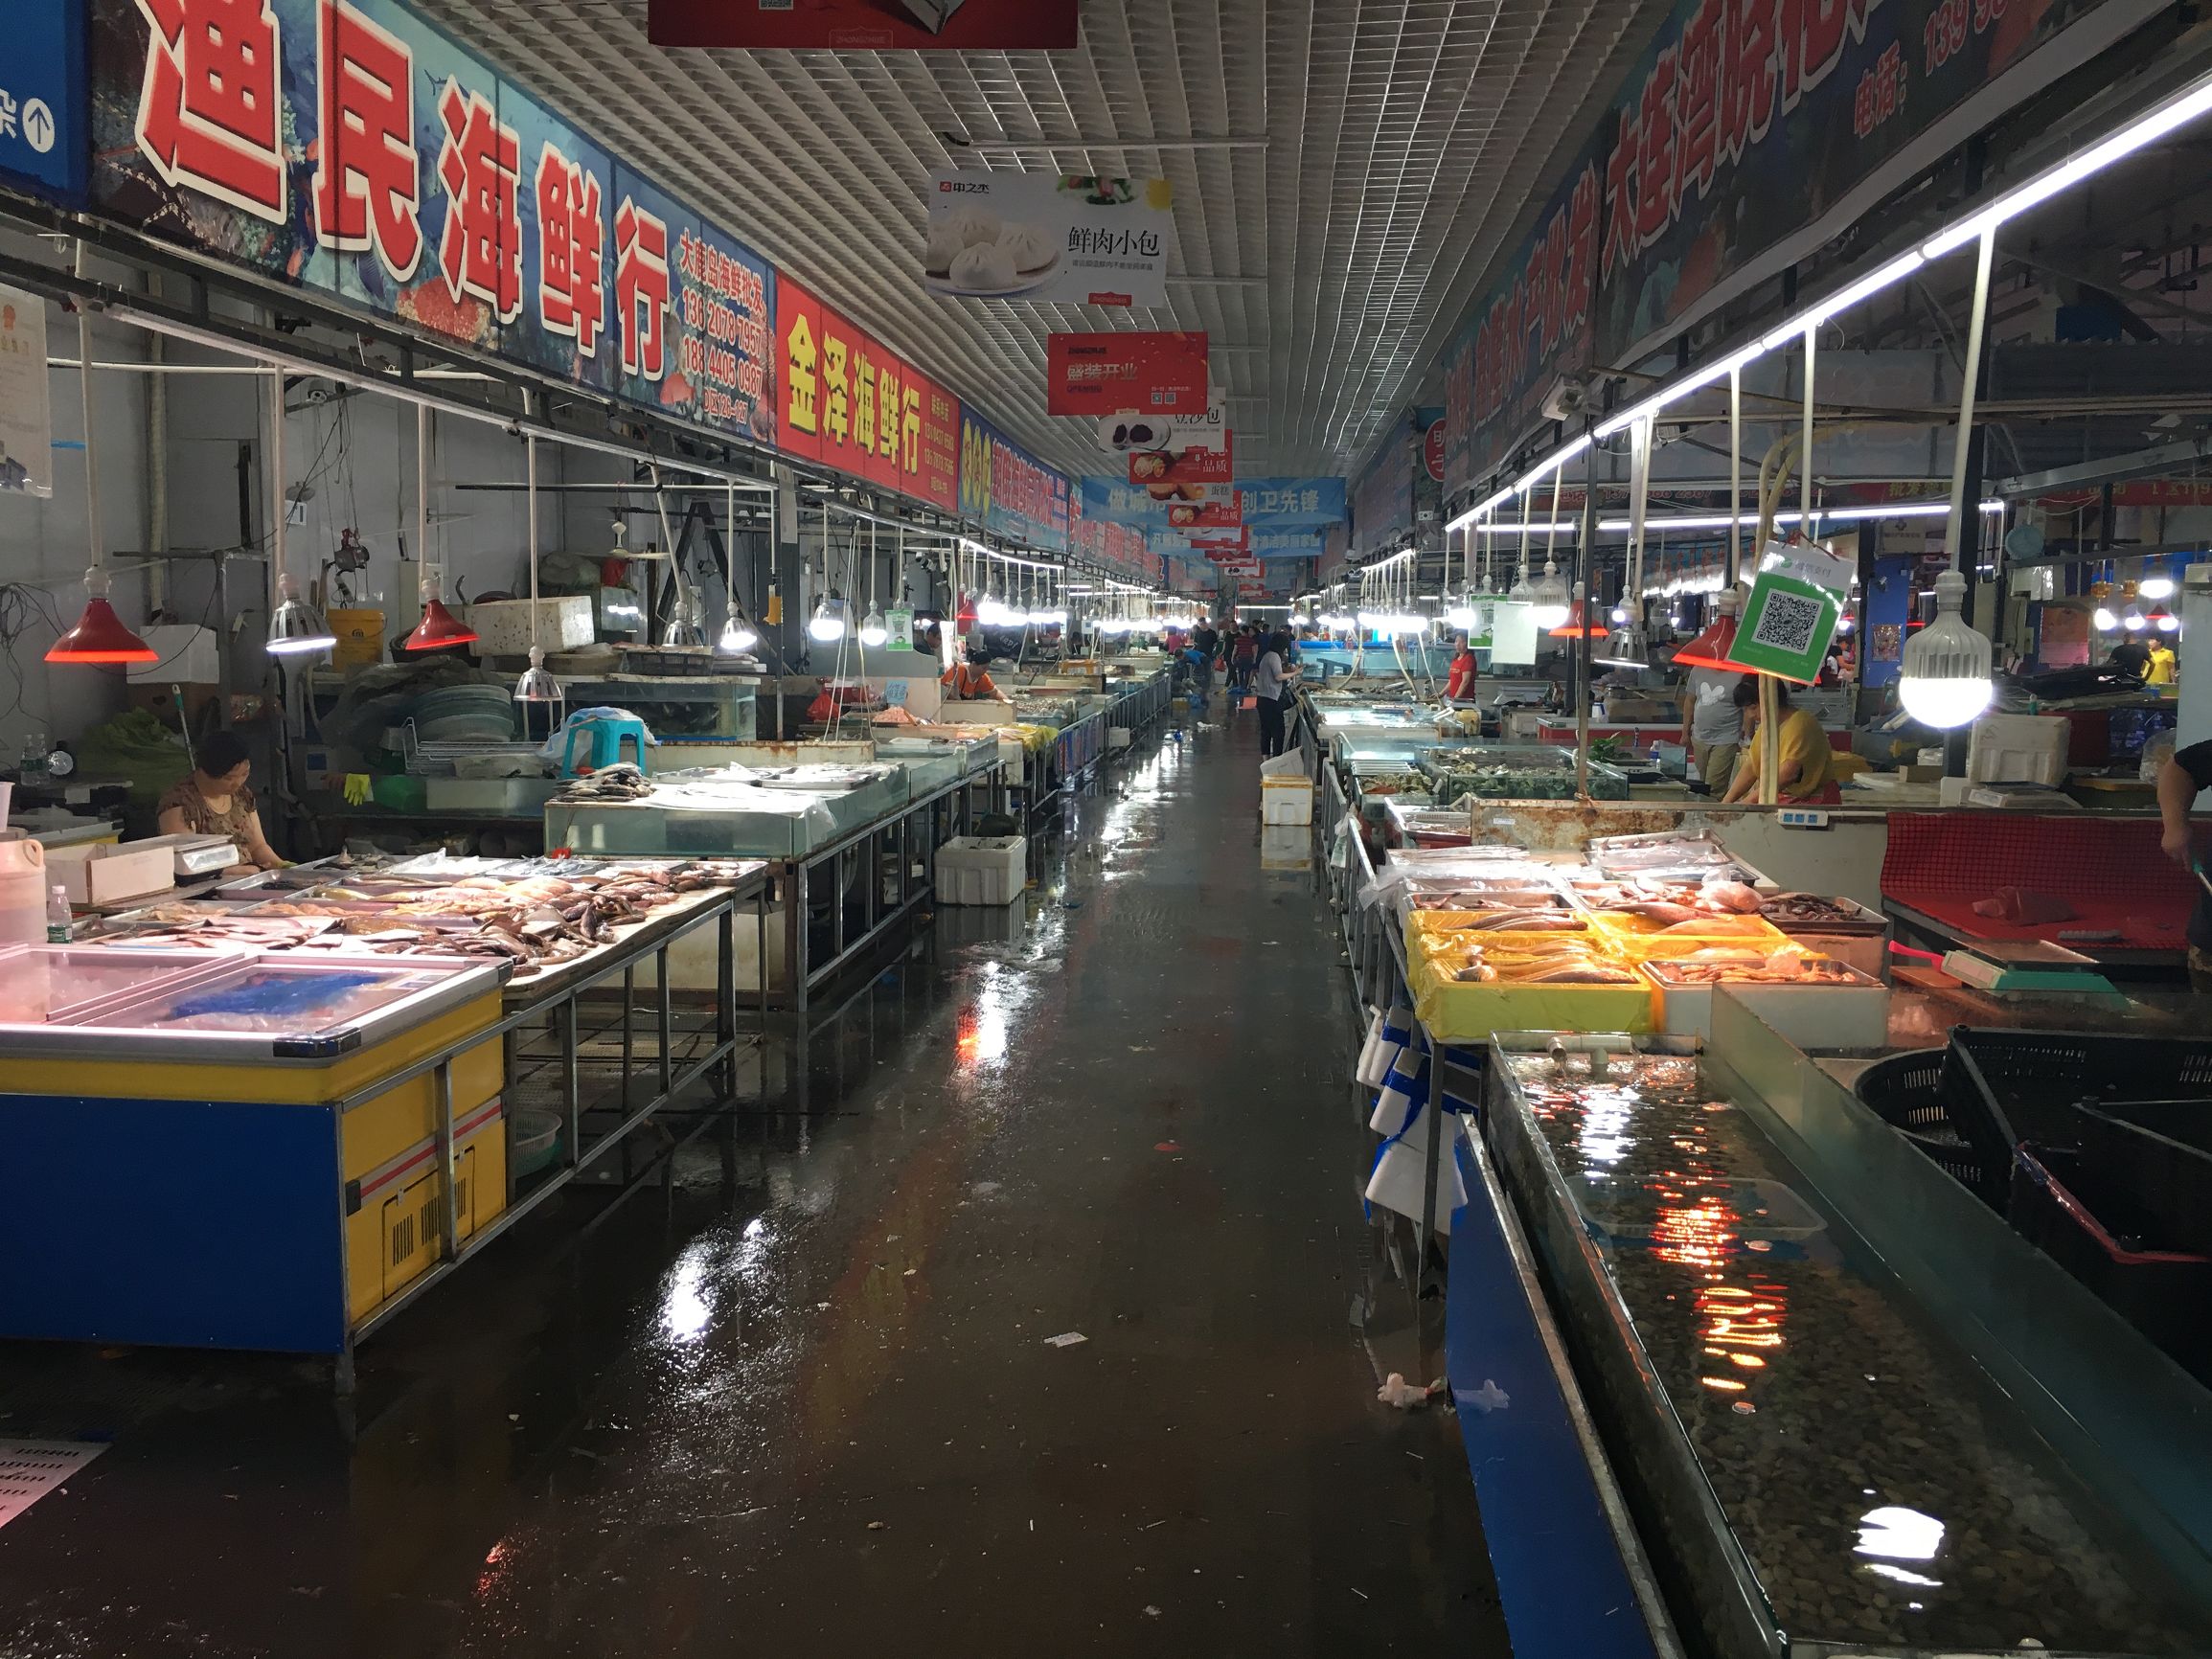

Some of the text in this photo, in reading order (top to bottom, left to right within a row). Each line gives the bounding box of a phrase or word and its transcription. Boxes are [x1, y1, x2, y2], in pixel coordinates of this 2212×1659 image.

[135, 0, 671, 381] 渔民海鲜行
[679, 227, 764, 315] 大鹿岛海鲜批发
[1067, 226, 1160, 257] 鲜肉小包
[707, 298, 736, 347] 2078
[737, 314, 763, 359] 7957
[683, 333, 764, 400] 188 4405 0987
[787, 313, 921, 476] 金泽海鲜行
[1066, 362, 1138, 382] 盛装开业
[1202, 460, 1227, 473] 品质
